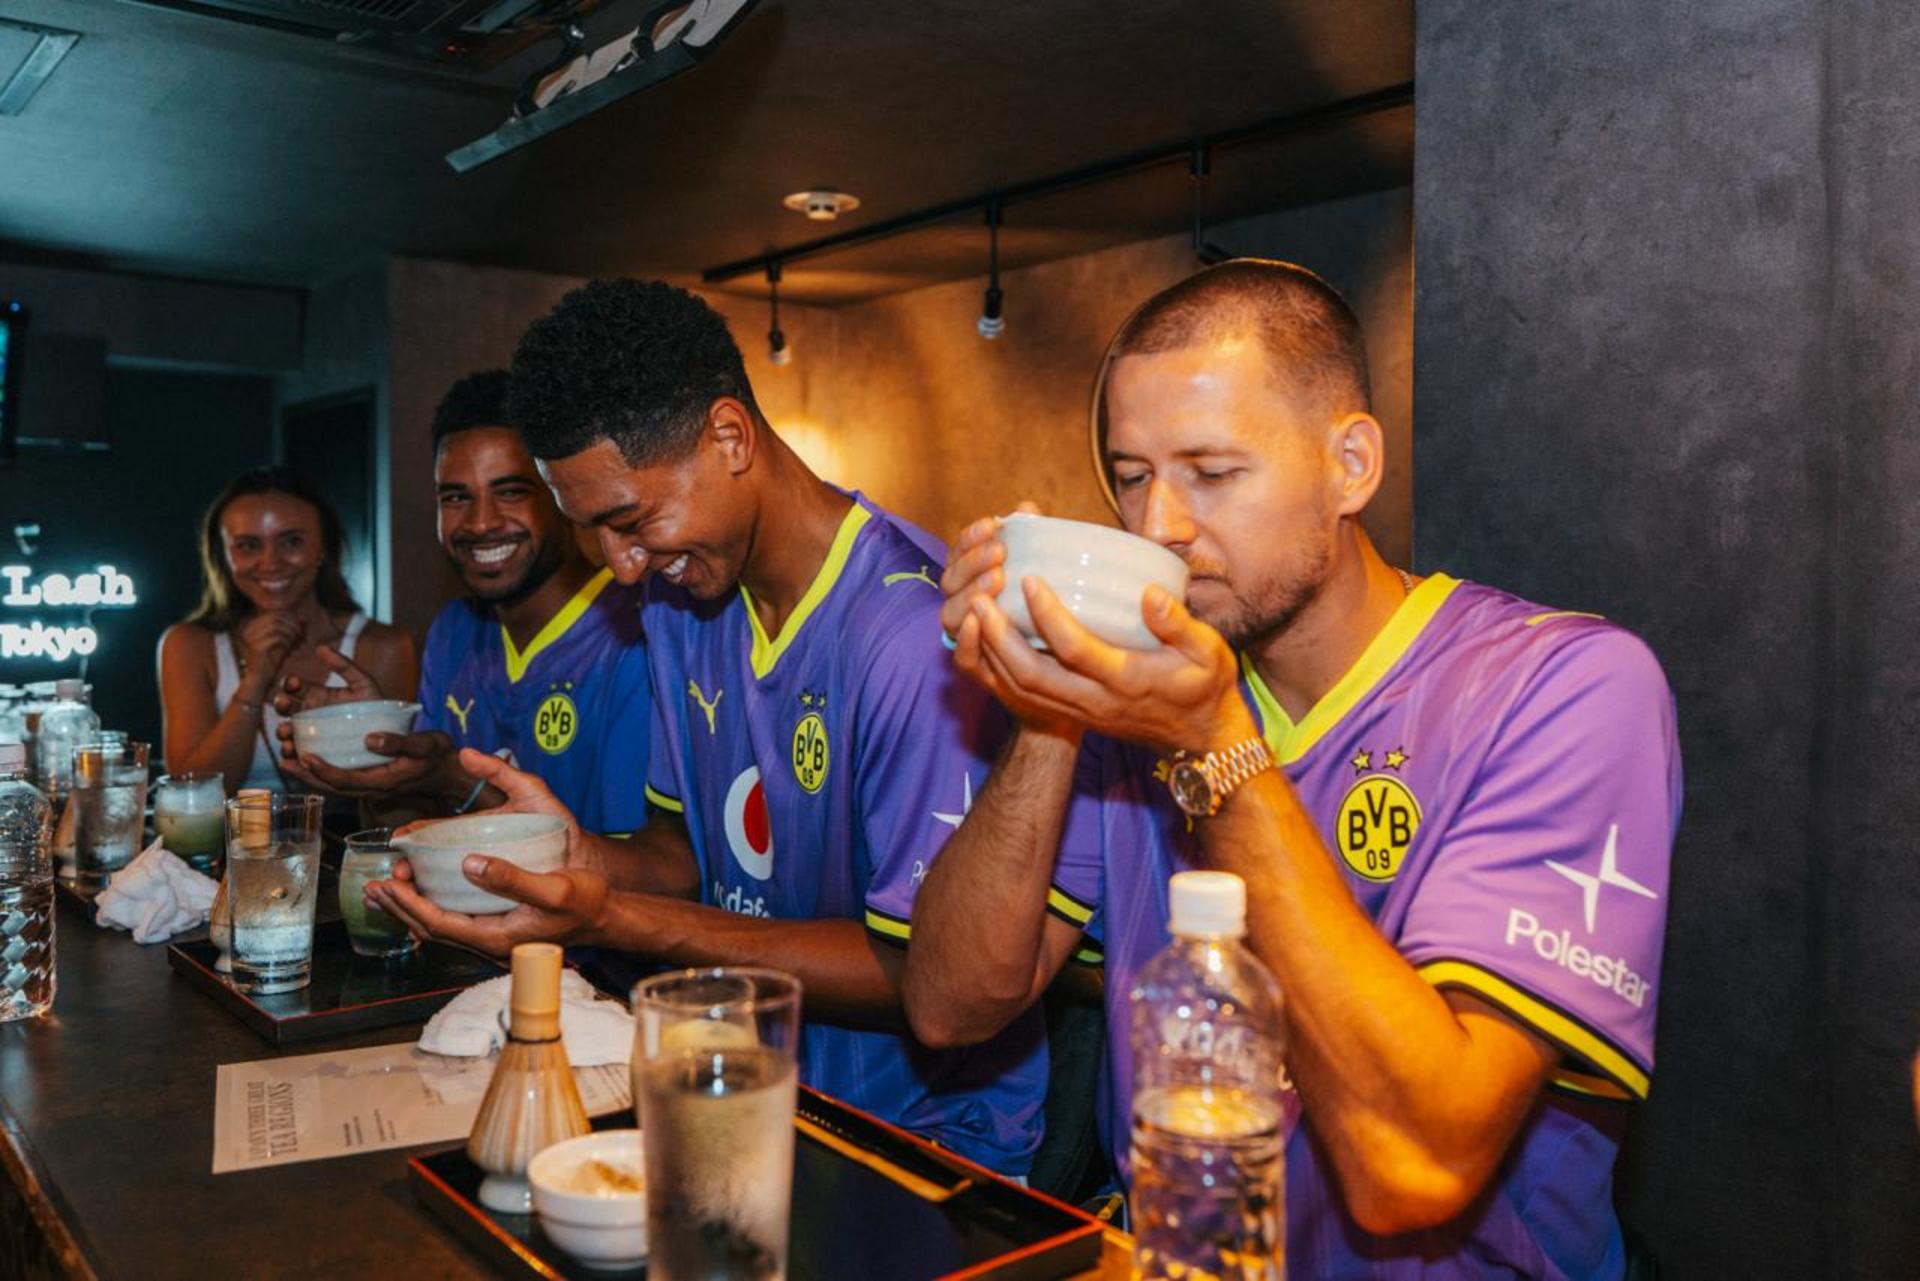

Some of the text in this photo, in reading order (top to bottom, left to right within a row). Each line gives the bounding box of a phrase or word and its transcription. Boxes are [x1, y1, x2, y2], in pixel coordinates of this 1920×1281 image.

[0, 621, 97, 662] Tokyo
[539, 700, 572, 735] BVB
[796, 720, 825, 771] BVB
[1348, 786, 1412, 852] BVB
[1366, 848, 1391, 871] 09
[1505, 907, 1651, 1009] Polestar
